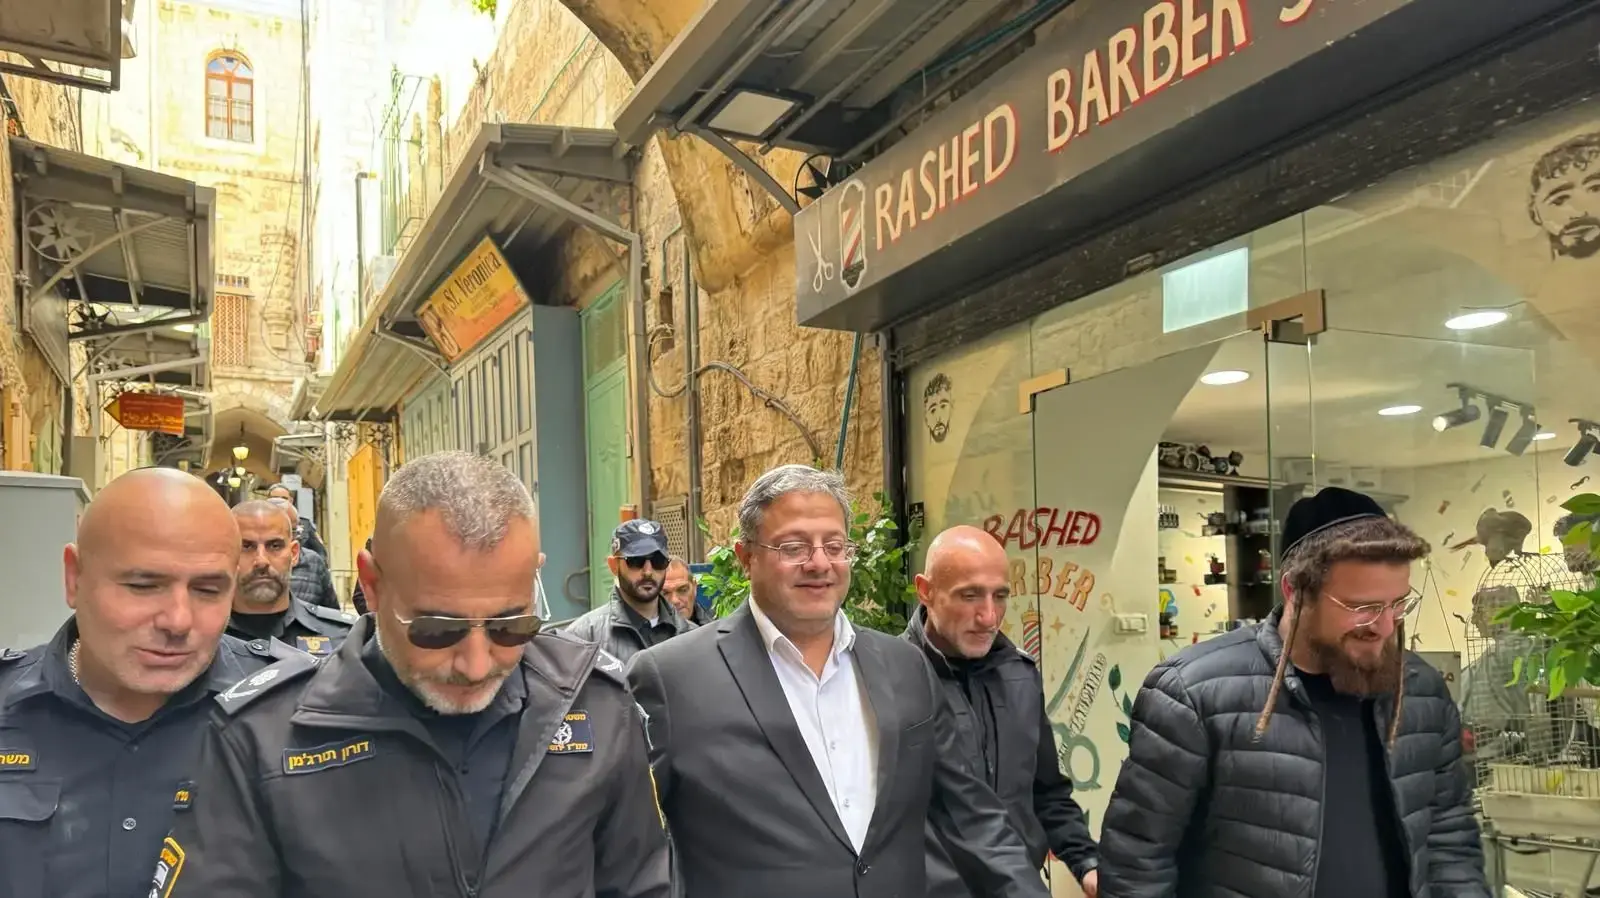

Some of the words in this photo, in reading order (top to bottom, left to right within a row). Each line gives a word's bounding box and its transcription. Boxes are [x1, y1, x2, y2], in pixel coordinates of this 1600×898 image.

[875, 103, 1018, 251] RASHED
[1047, 0, 1253, 153] BARBER
[454, 251, 502, 298] Veronica
[983, 507, 1103, 550] RASHED
[1009, 556, 1096, 612] RBER
[341, 740, 370, 761] דורון
